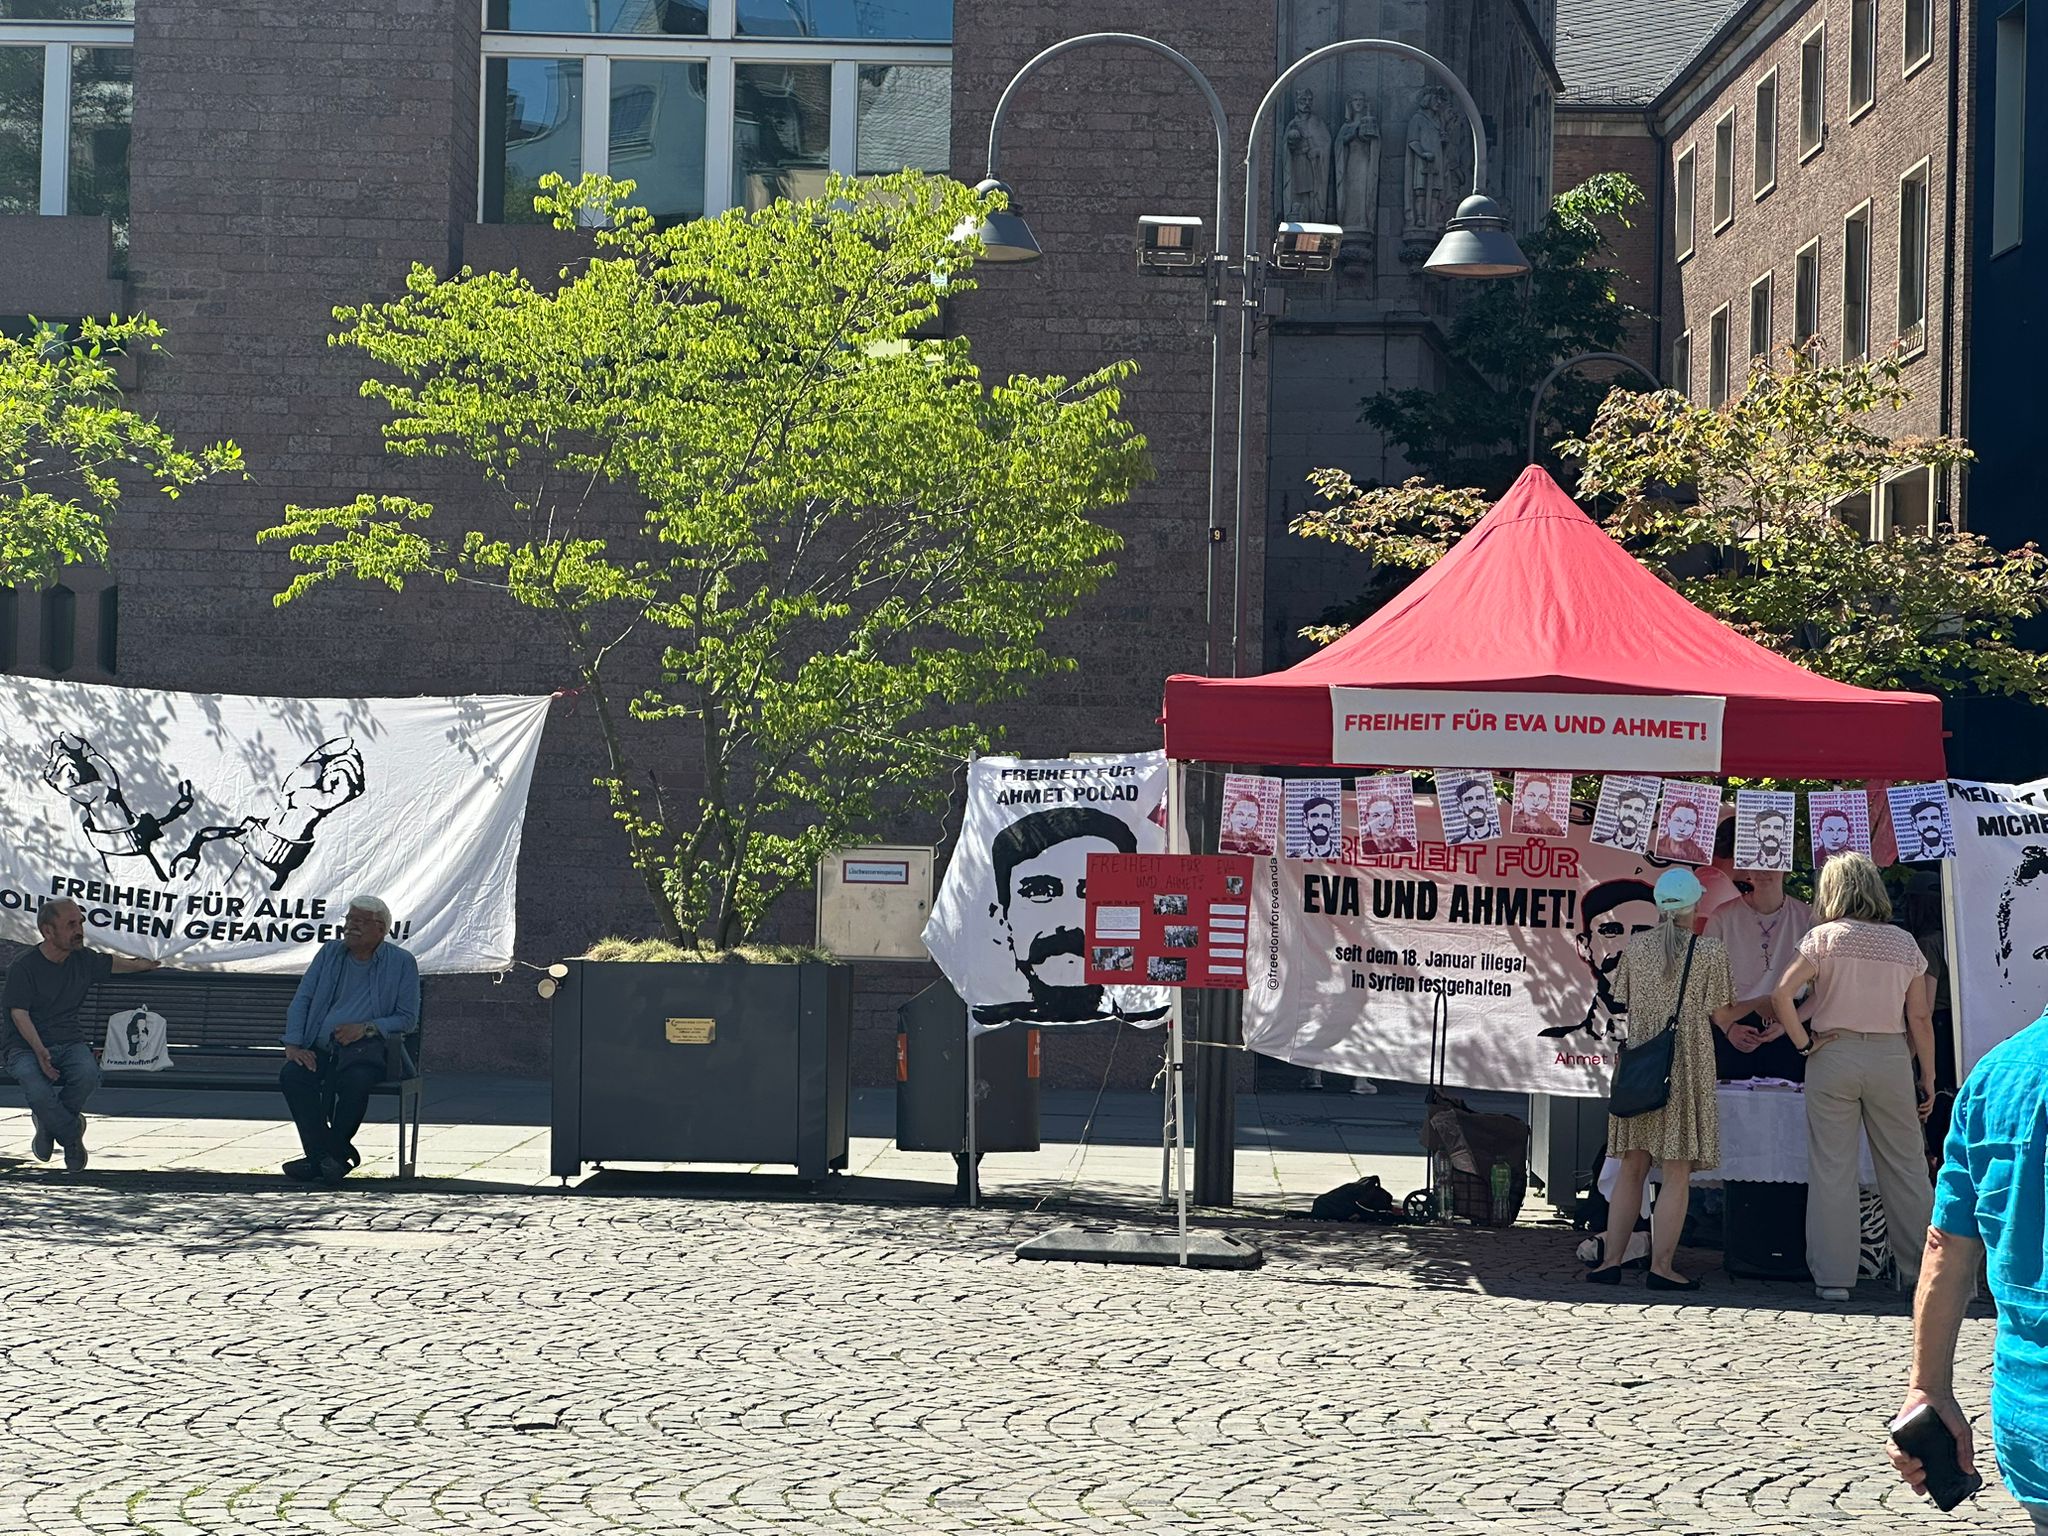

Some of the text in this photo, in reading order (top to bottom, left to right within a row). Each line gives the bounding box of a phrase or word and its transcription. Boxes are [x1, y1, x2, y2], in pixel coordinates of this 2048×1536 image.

[1214, 530, 1220, 540] 9
[1345, 709, 1707, 741] FREIHEIT FÜR EVA UND AHMET!
[1002, 765, 1135, 781] FREIHEIT FÜR
[997, 784, 1138, 805] AHMET POLAD
[1091, 856, 1163, 873] FREIHEIT
[1216, 859, 1236, 874] EVA
[1496, 838, 1579, 878] FÜR
[1136, 875, 1157, 889] UND
[51, 876, 326, 919] FREIHEIT FÜR ALLE
[1304, 874, 1576, 929] EVA UND AHMET!
[1335, 945, 1527, 974] seit dem 18. Januar illegal
[1351, 970, 1512, 997] in Syrien festgehalten
[1555, 1052, 1608, 1065] Ahmet
